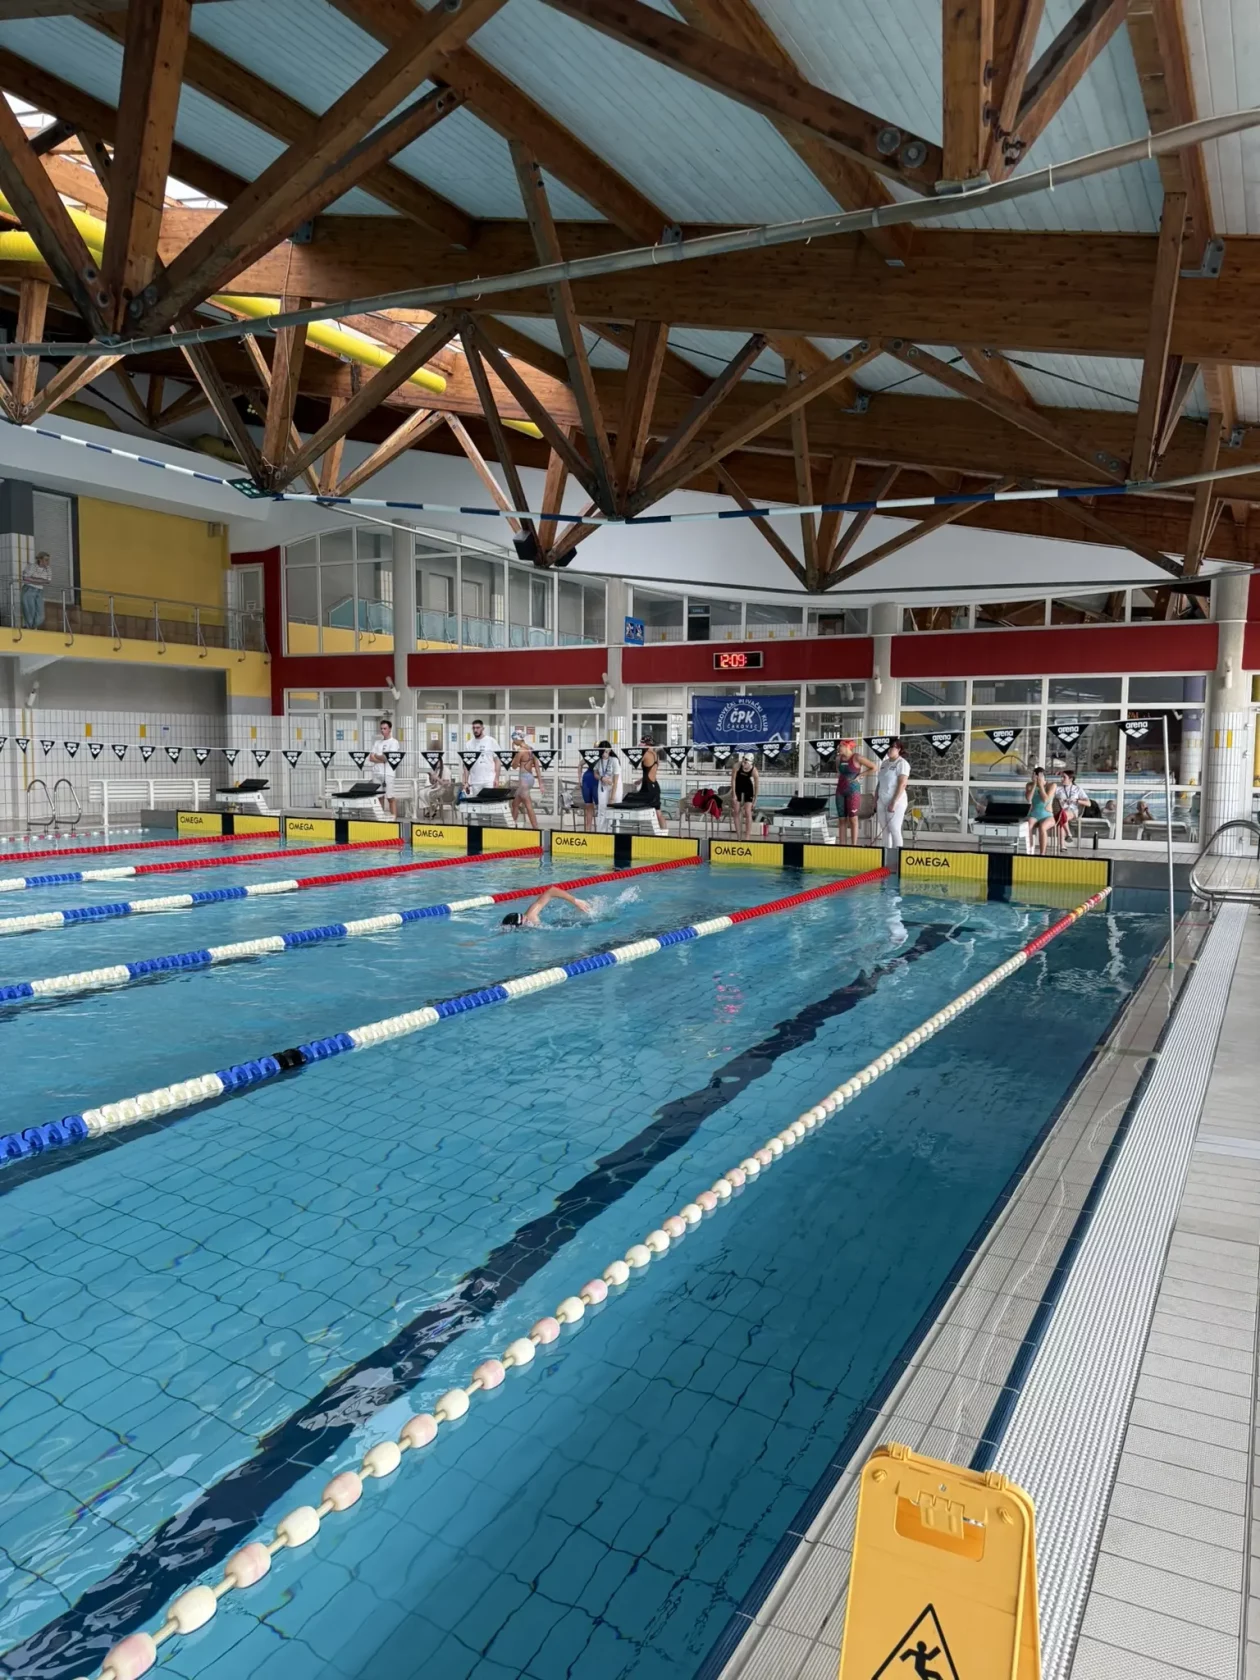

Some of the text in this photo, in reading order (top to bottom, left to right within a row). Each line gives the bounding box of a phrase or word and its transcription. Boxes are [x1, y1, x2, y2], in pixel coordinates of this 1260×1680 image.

[729, 707, 755, 724] ČPK
[738, 699, 763, 712] PLIVAČKI
[761, 714, 769, 732] KLUB
[1057, 725, 1080, 733] arena
[1125, 721, 1149, 729] arena
[932, 733, 951, 741] arena
[993, 729, 1014, 738] arena
[180, 815, 204, 825] OMEGA
[288, 822, 314, 832] OMEGA
[415, 829, 444, 839] OMEGA
[555, 837, 588, 847] OMEGA
[714, 846, 753, 857] OMEGA
[905, 856, 950, 868] OMEGA
